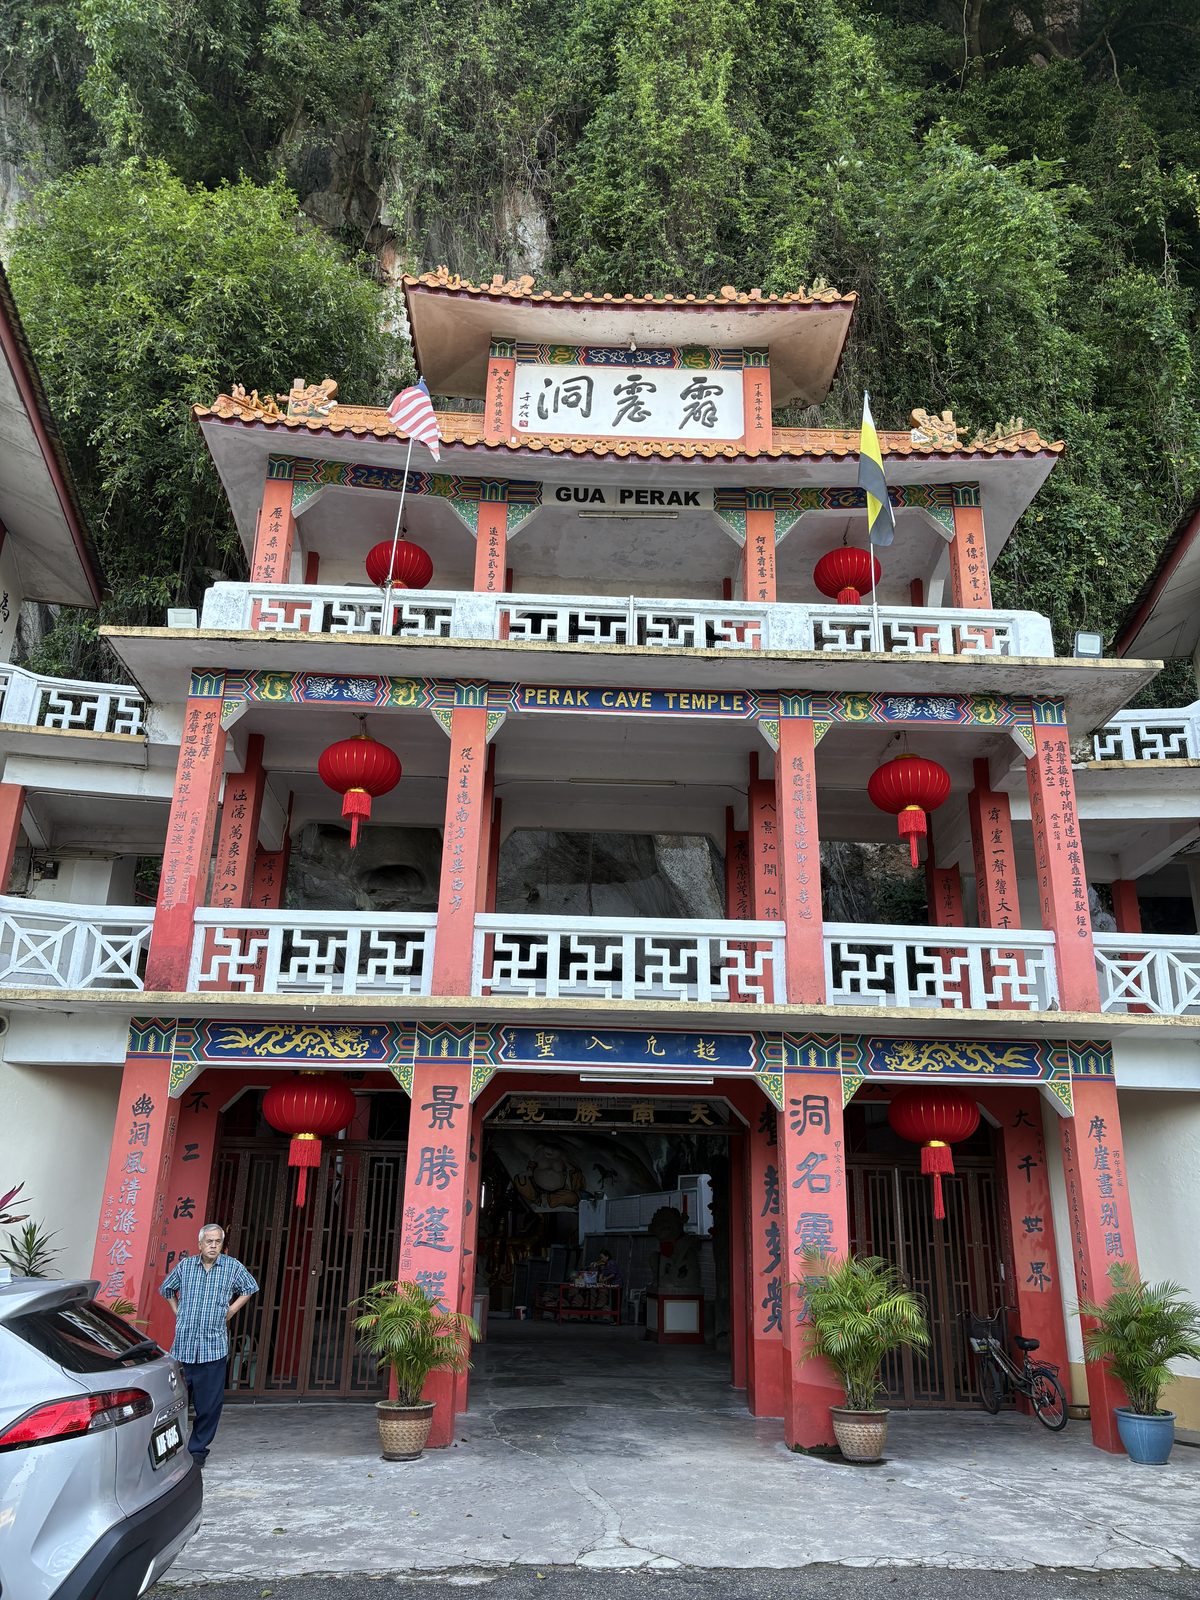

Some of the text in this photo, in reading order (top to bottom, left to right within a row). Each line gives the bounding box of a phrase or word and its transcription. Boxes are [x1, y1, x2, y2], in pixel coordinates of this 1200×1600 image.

[555, 486, 701, 506] GUA PERAK
[524, 688, 744, 711] PERAK CAVE TEMPLE
[1012, 1109, 1052, 1293] 大千世界
